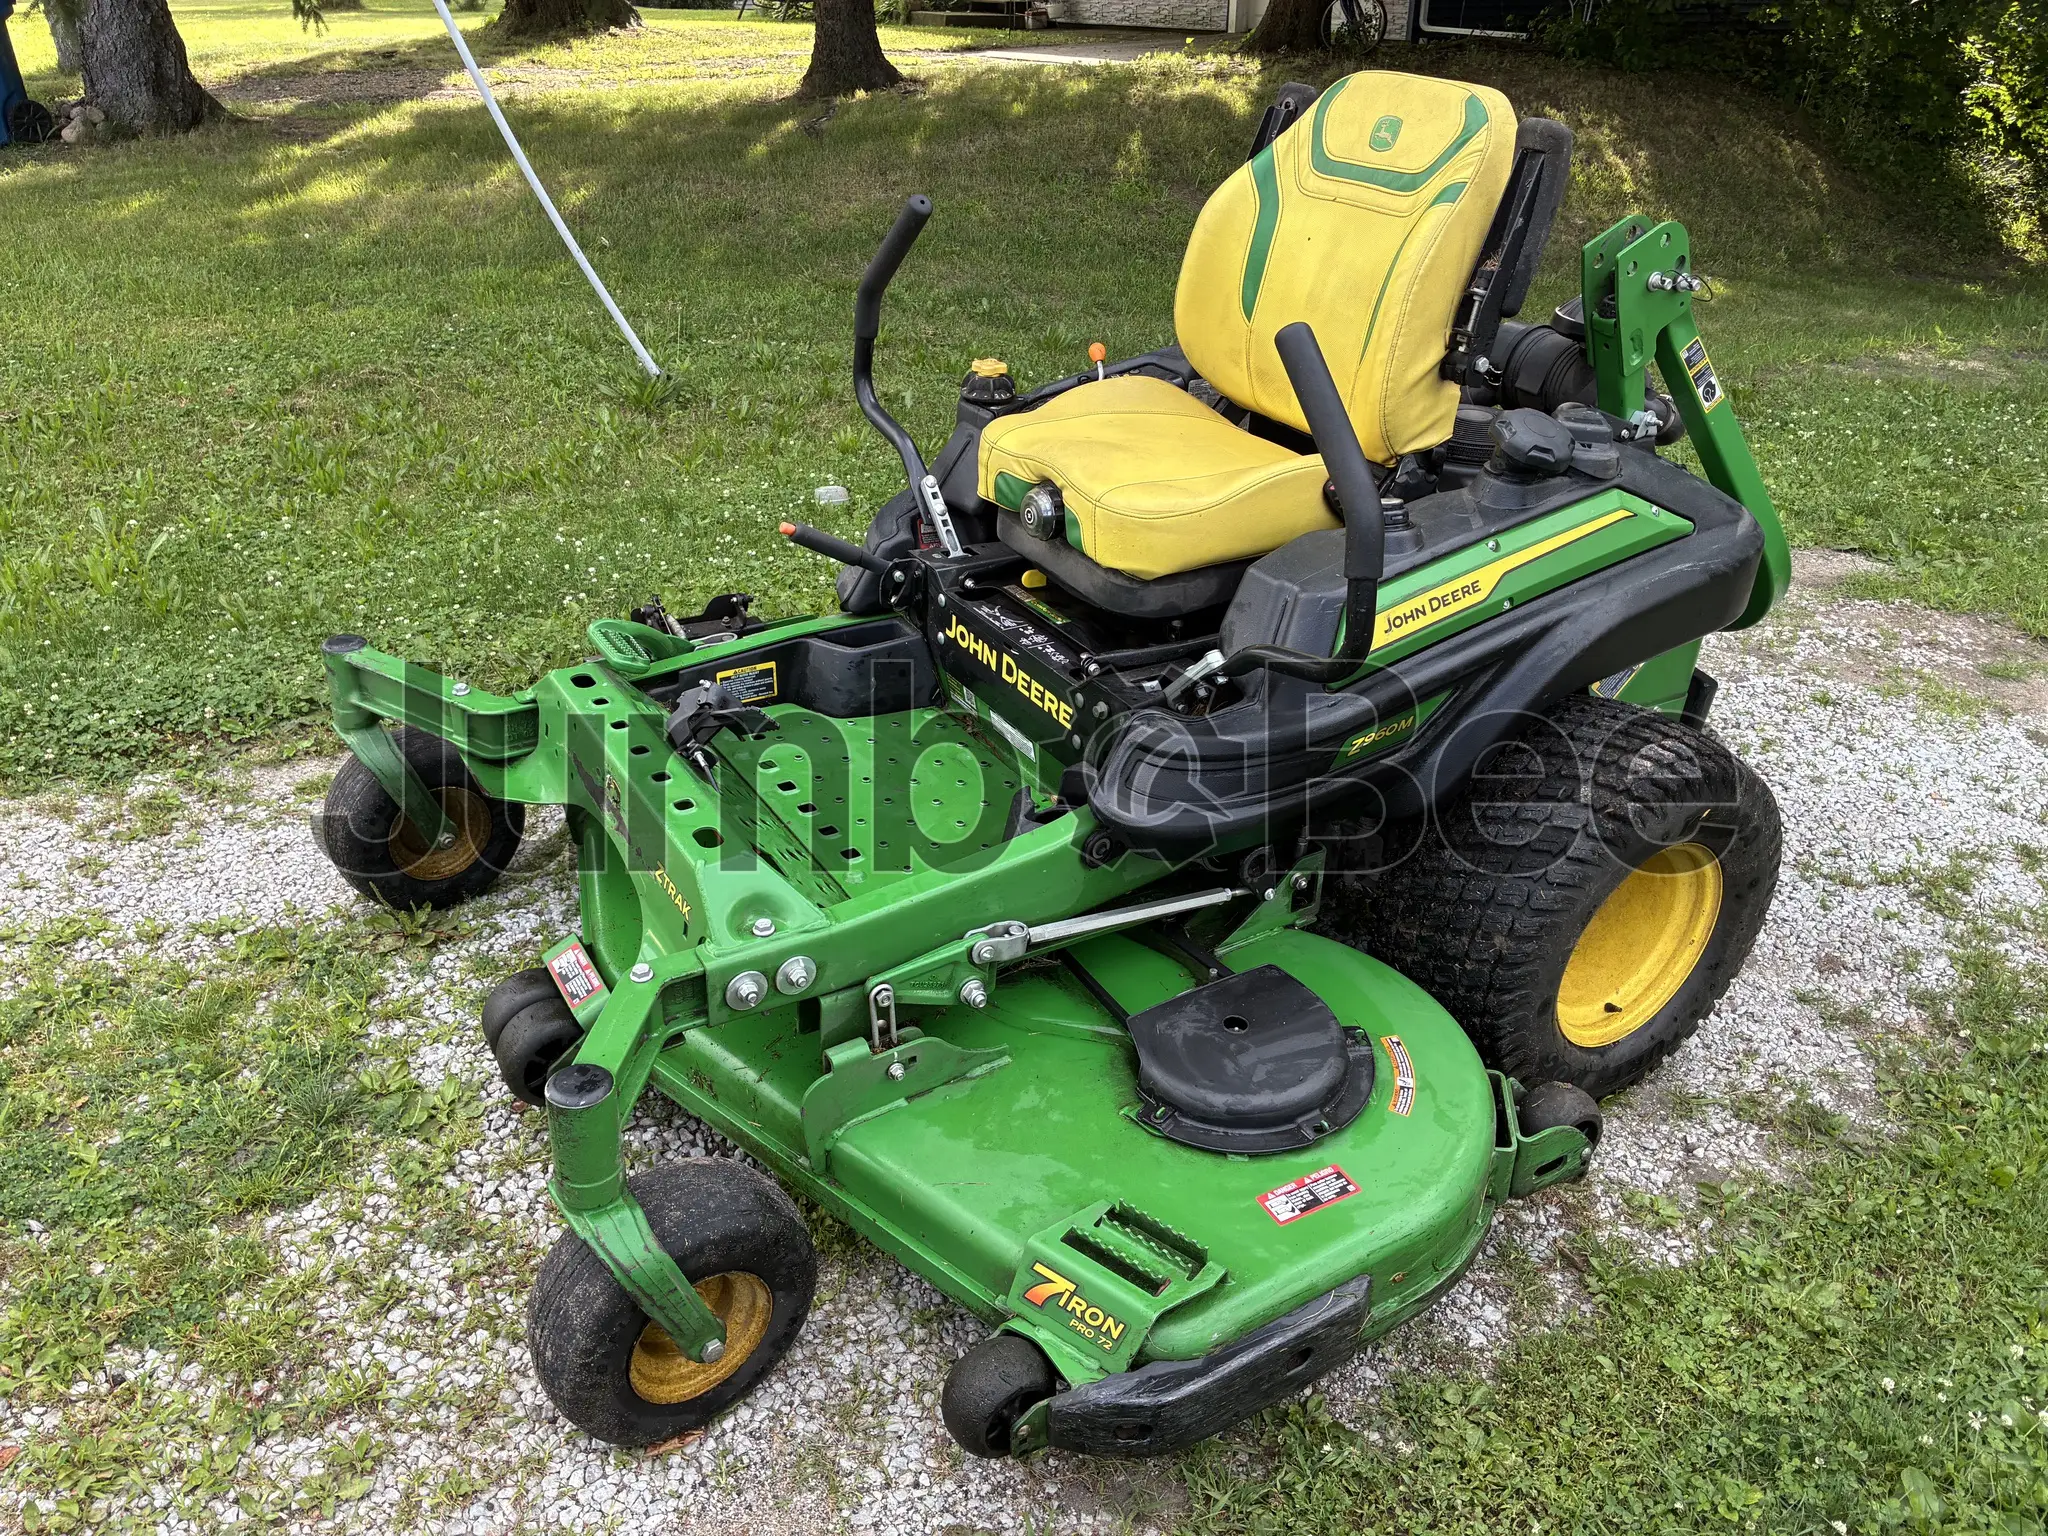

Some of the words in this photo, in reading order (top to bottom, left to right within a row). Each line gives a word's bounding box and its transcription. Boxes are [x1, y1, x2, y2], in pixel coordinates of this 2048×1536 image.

[1384, 605, 1427, 633] JOHN
[1429, 579, 1482, 613] DEERE
[945, 614, 997, 672] JOHN
[1001, 652, 1073, 731] DEERE
[1347, 716, 1415, 756] Z960M
[1069, 1318, 1095, 1339] PRO
[1098, 1335, 1114, 1351] 72
